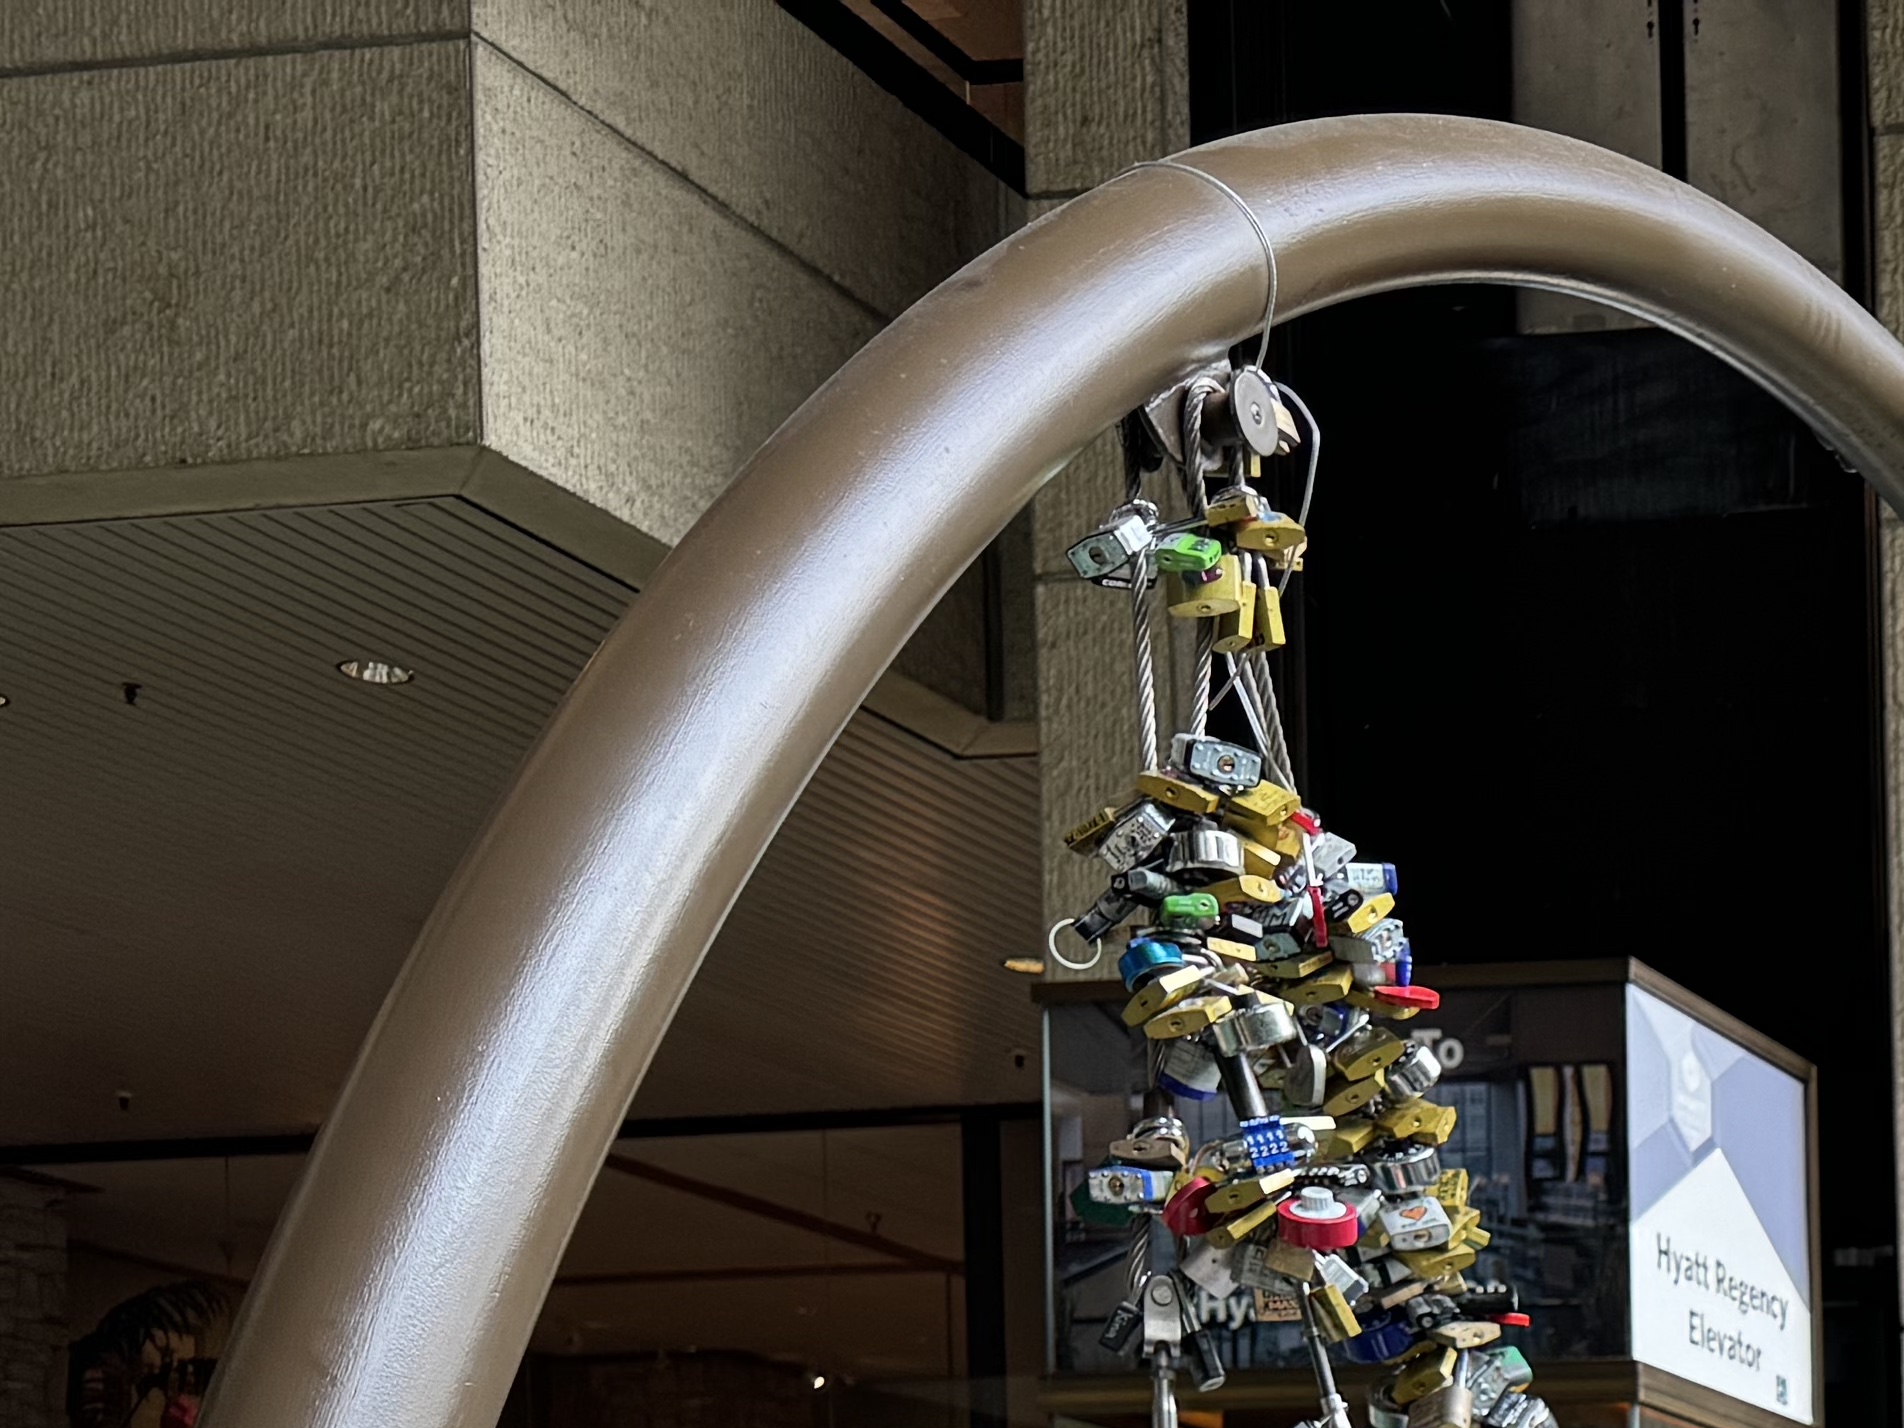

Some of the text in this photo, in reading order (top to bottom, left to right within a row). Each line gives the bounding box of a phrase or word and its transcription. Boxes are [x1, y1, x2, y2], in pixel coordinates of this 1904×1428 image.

[1656, 1232, 1790, 1331] Hyatt Regency
[1688, 1310, 1763, 1372] Elevator
